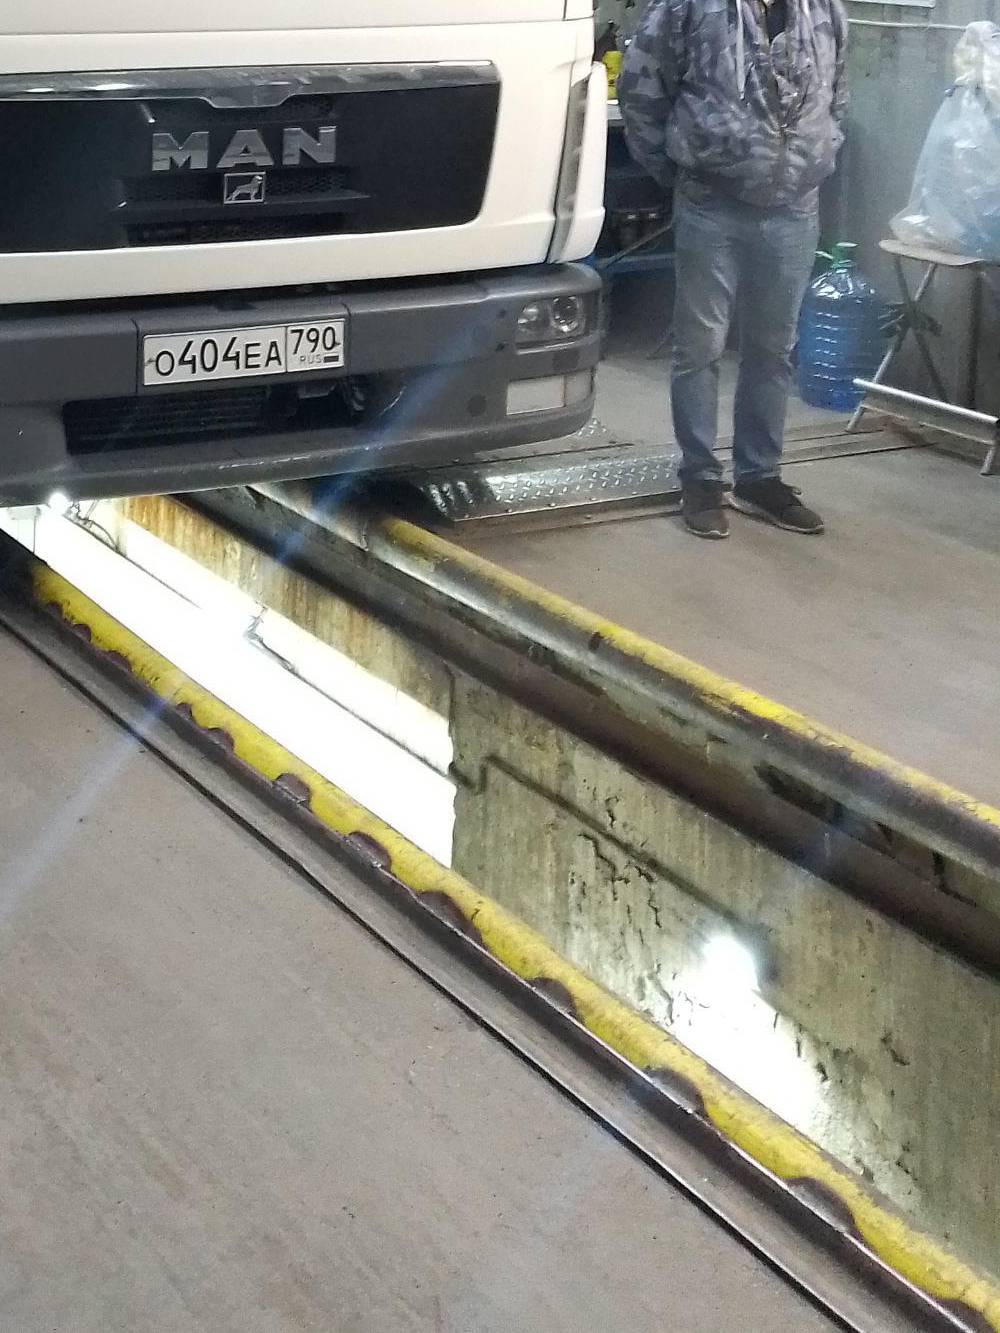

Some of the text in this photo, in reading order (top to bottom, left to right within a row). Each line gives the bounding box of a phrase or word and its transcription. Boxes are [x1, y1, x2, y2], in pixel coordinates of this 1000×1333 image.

[151, 125, 338, 171] MAN
[155, 325, 337, 377] О404ЕА 790
[299, 354, 322, 365] RUS
